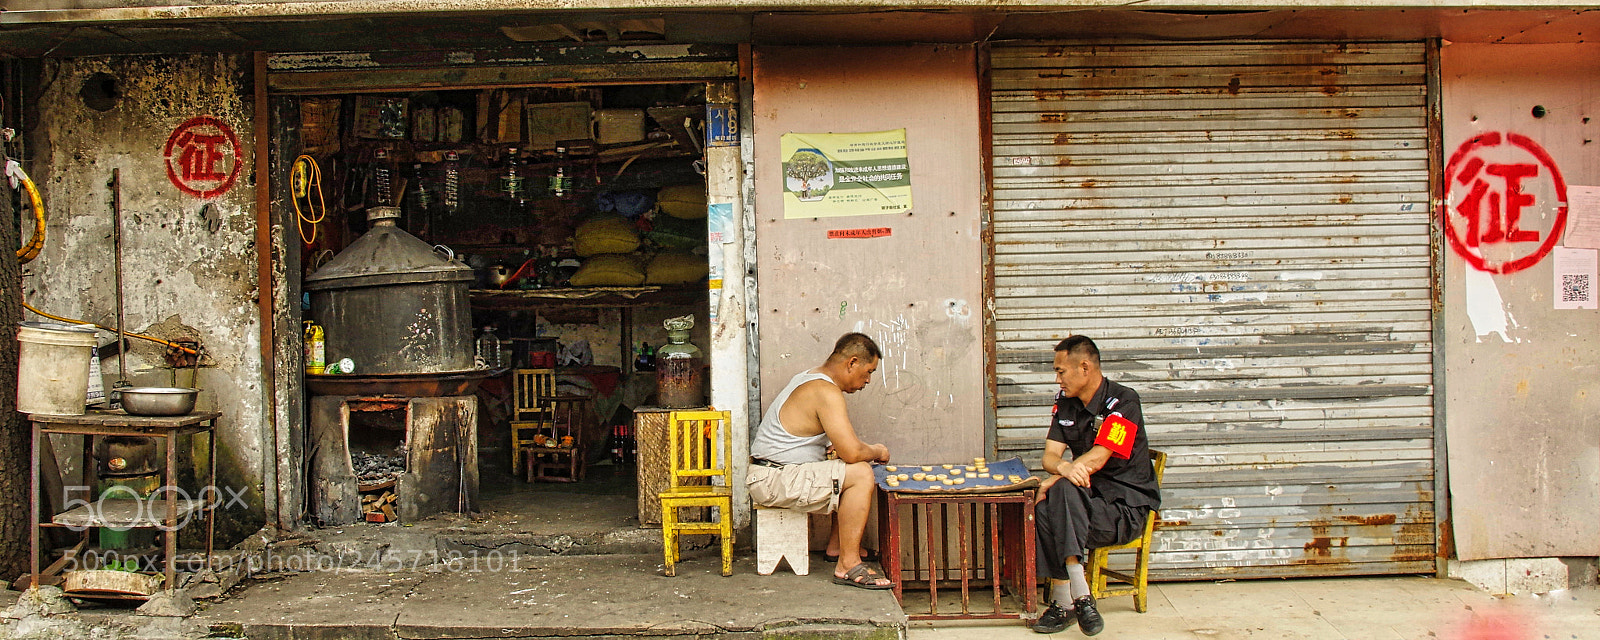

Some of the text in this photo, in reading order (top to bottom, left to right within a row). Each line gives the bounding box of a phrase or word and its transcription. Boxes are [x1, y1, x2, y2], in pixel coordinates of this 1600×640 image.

[176, 131, 226, 181] 征
[1456, 157, 1540, 248] 征
[1106, 421, 1127, 446] 勤
